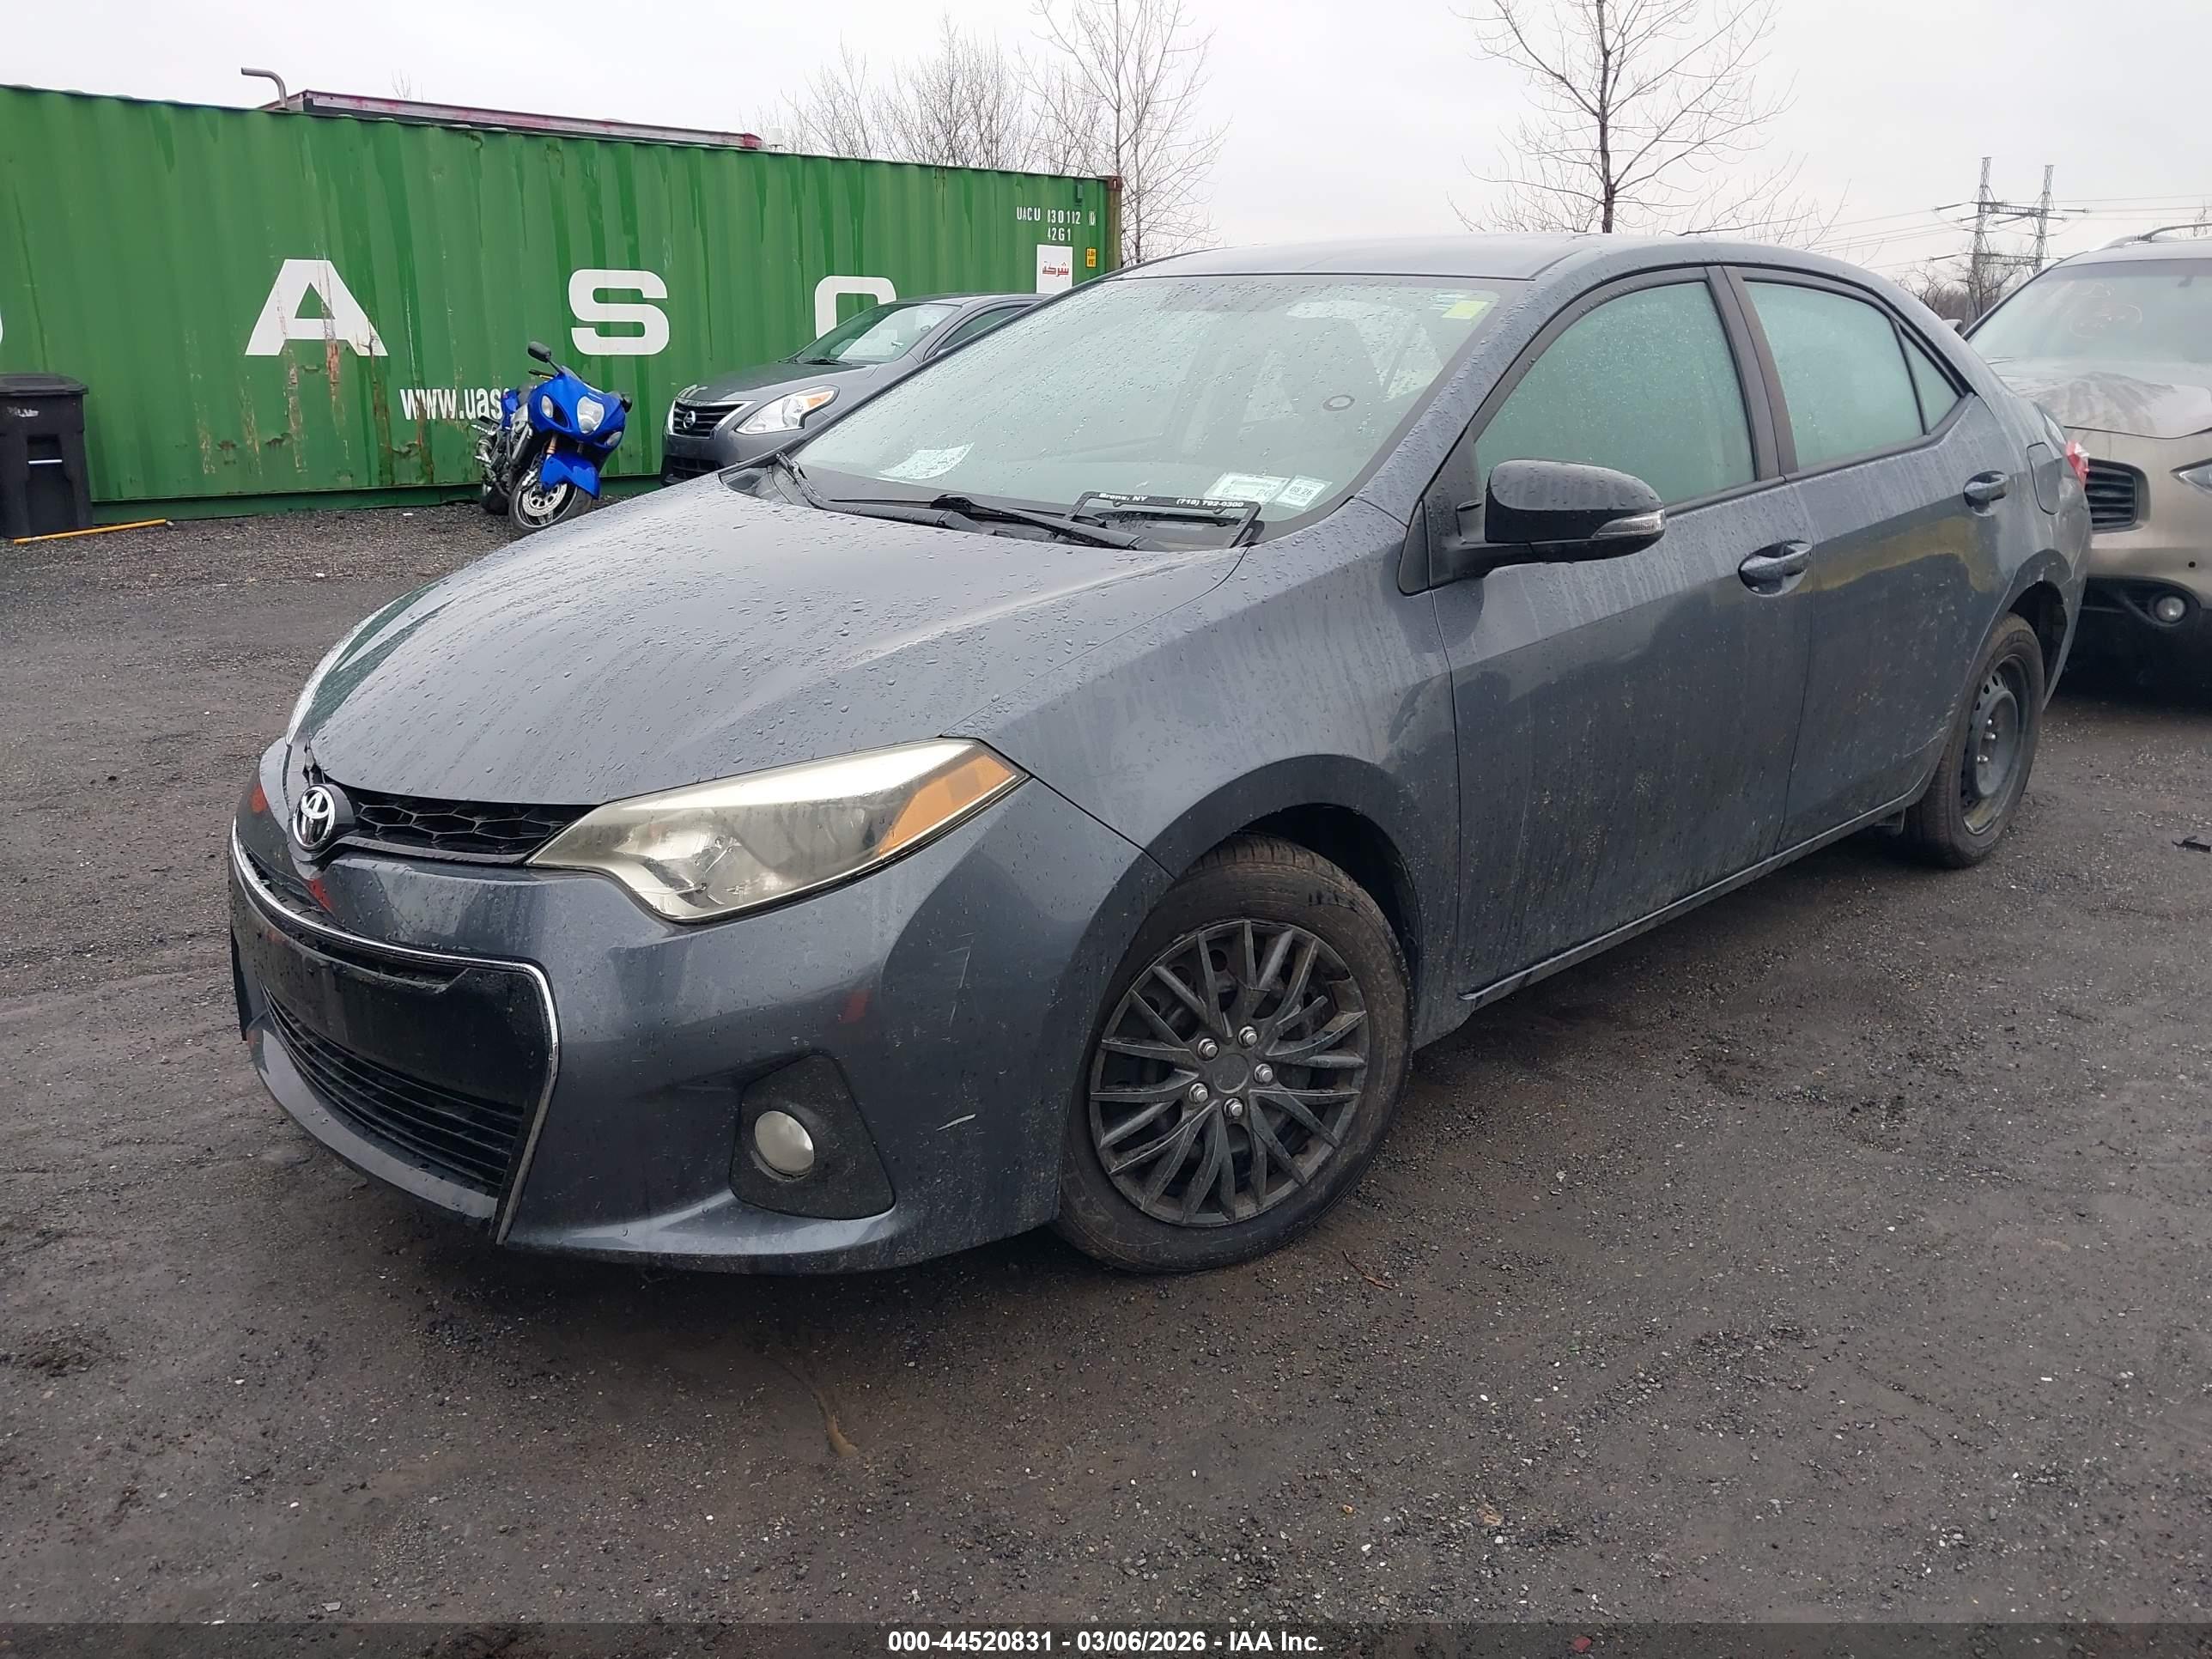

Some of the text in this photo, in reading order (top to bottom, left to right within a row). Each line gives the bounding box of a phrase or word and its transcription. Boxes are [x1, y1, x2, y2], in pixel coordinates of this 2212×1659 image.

[1016, 206, 1041, 221] UACU
[1047, 227, 1071, 240] 42G1
[1176, 498, 1200, 507] (718)
